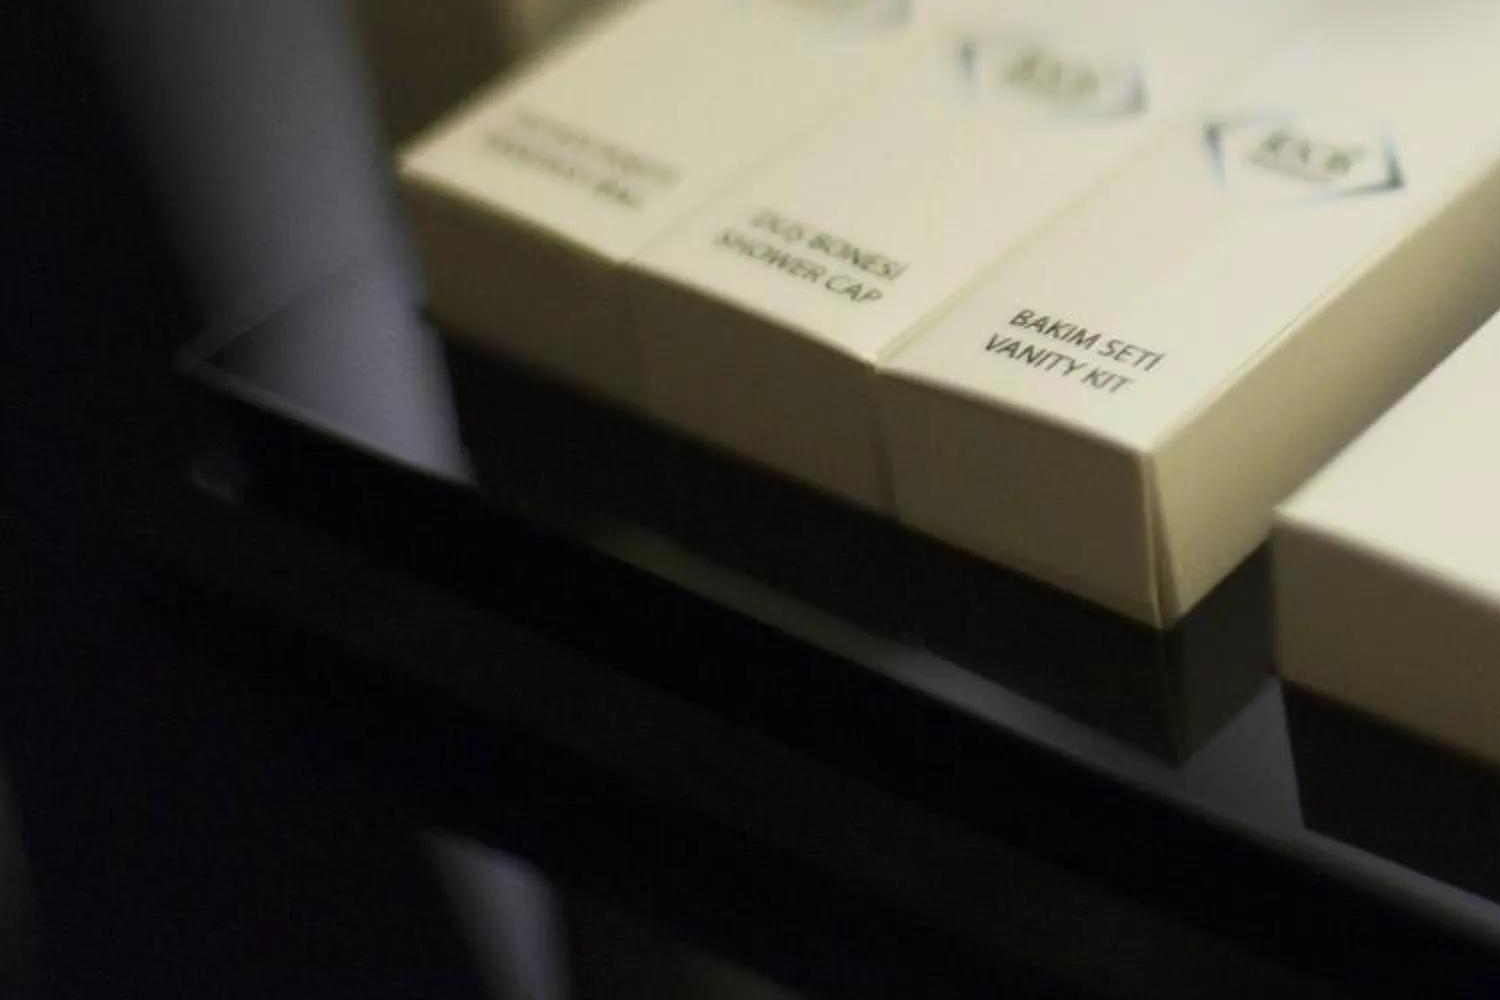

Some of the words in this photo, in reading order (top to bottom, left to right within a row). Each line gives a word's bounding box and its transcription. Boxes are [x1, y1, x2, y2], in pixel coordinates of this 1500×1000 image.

[824, 274, 884, 303] CAP
[1008, 308, 1102, 351] BAKIM
[985, 332, 1088, 377] VANITY
[1080, 366, 1137, 394] KIT
